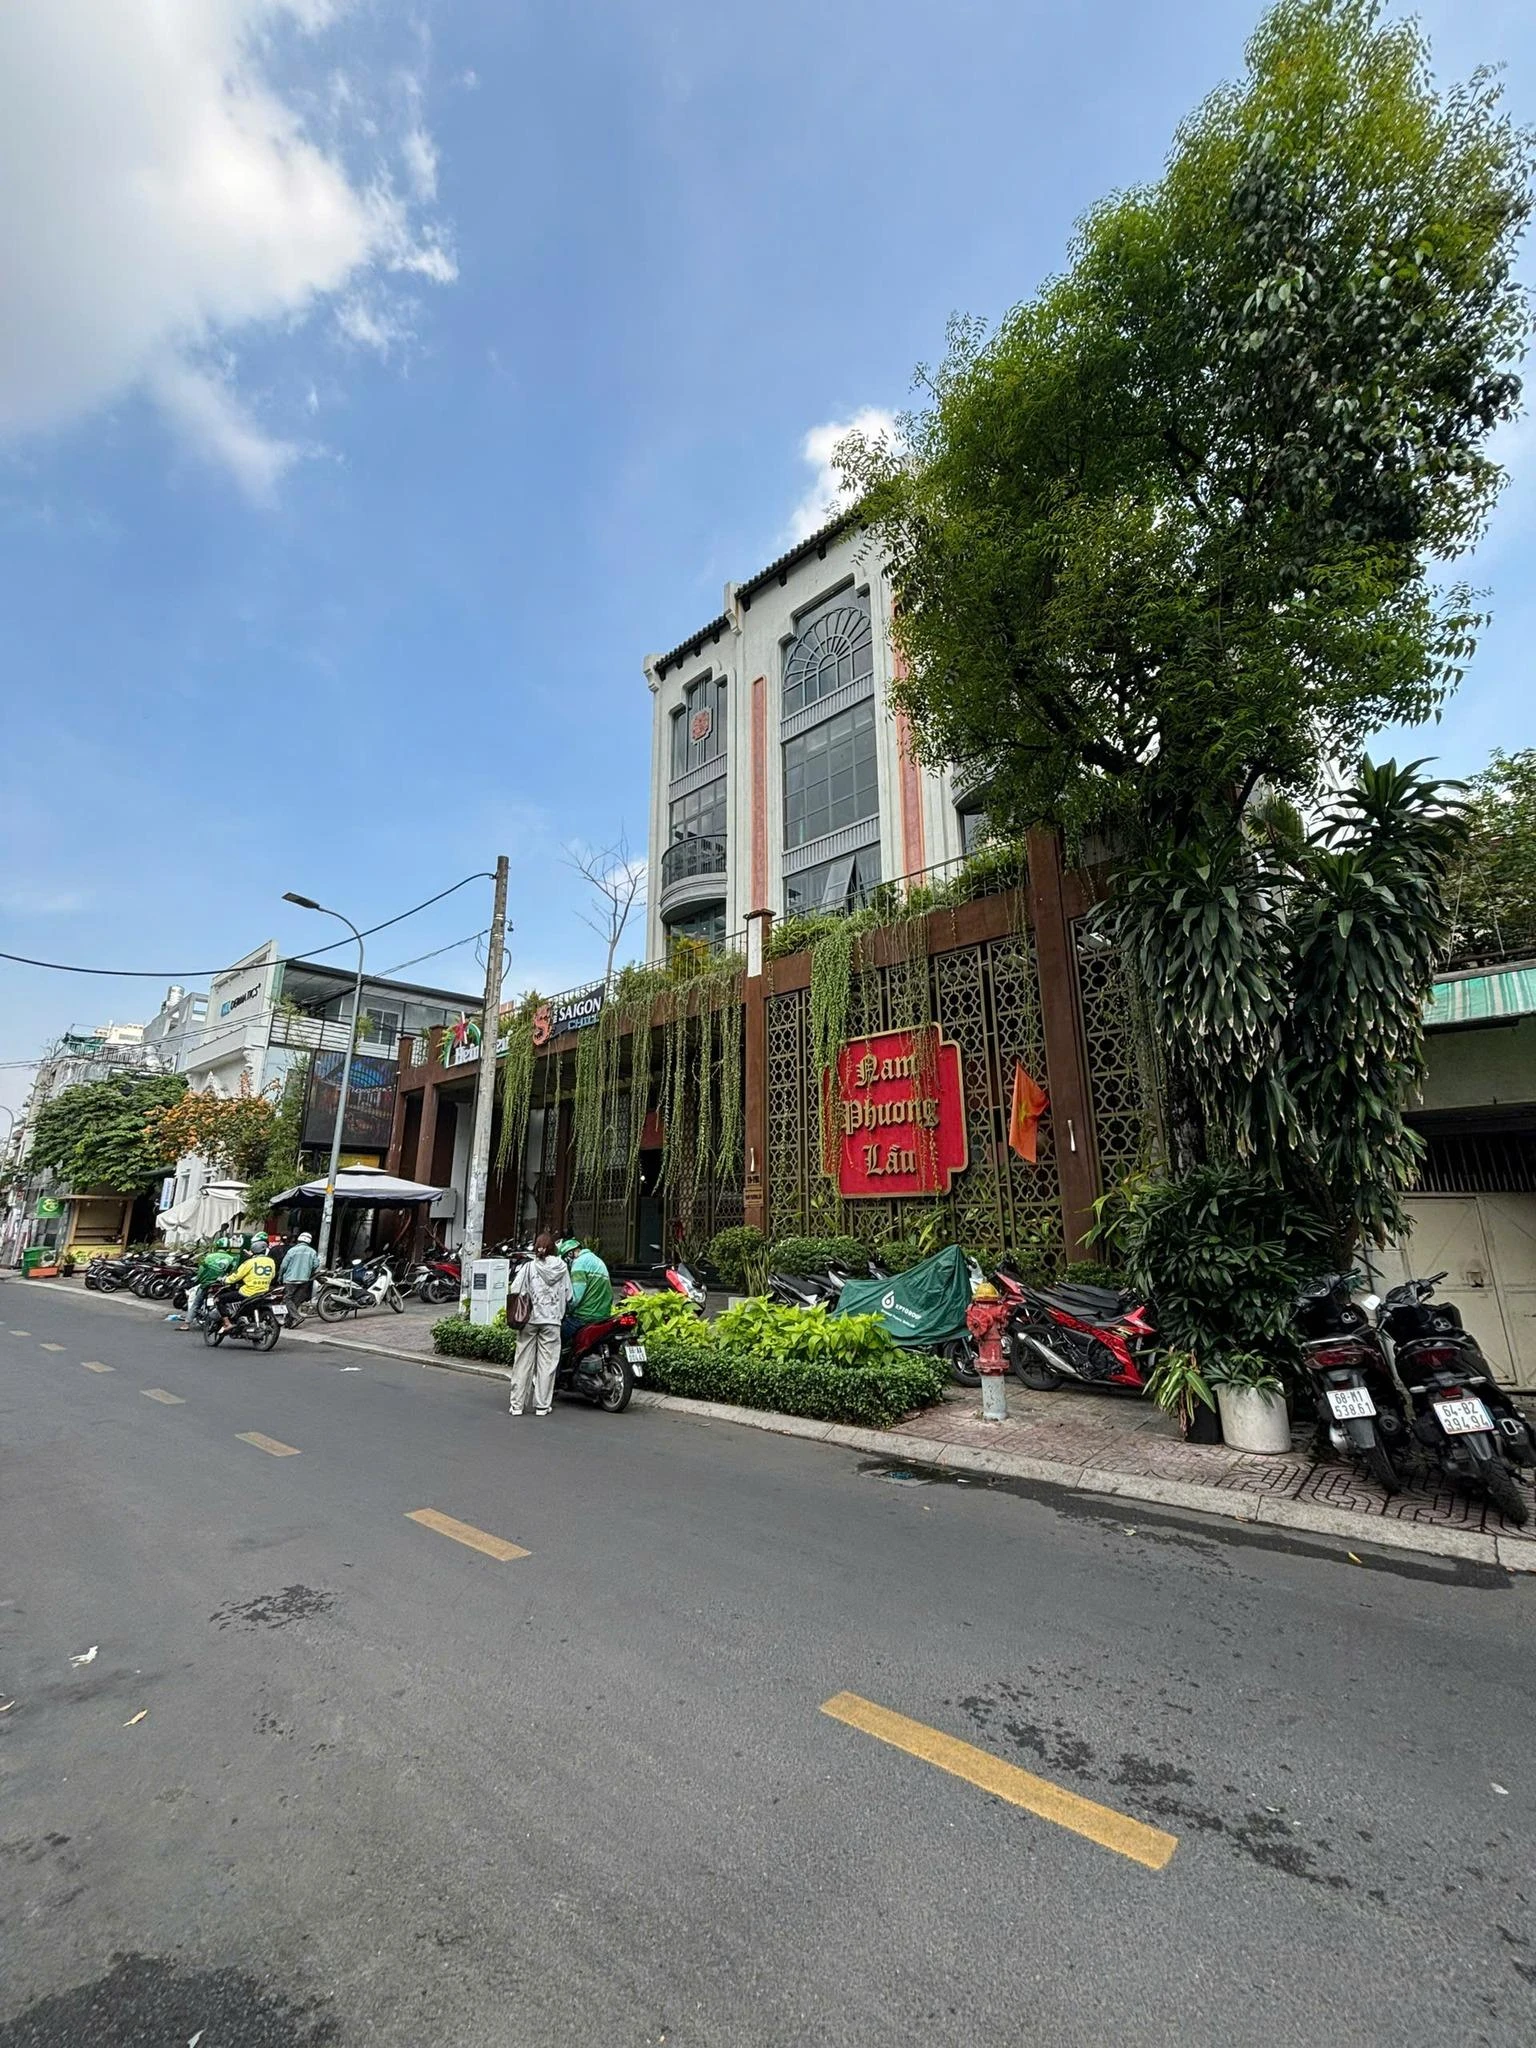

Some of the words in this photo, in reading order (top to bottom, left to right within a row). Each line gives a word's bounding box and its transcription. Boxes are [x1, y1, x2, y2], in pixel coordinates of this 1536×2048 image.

[558, 996, 602, 1022] SAIGON
[455, 1036, 510, 1064] Heinen
[854, 1053, 919, 1088] Nam
[254, 1262, 273, 1276] be
